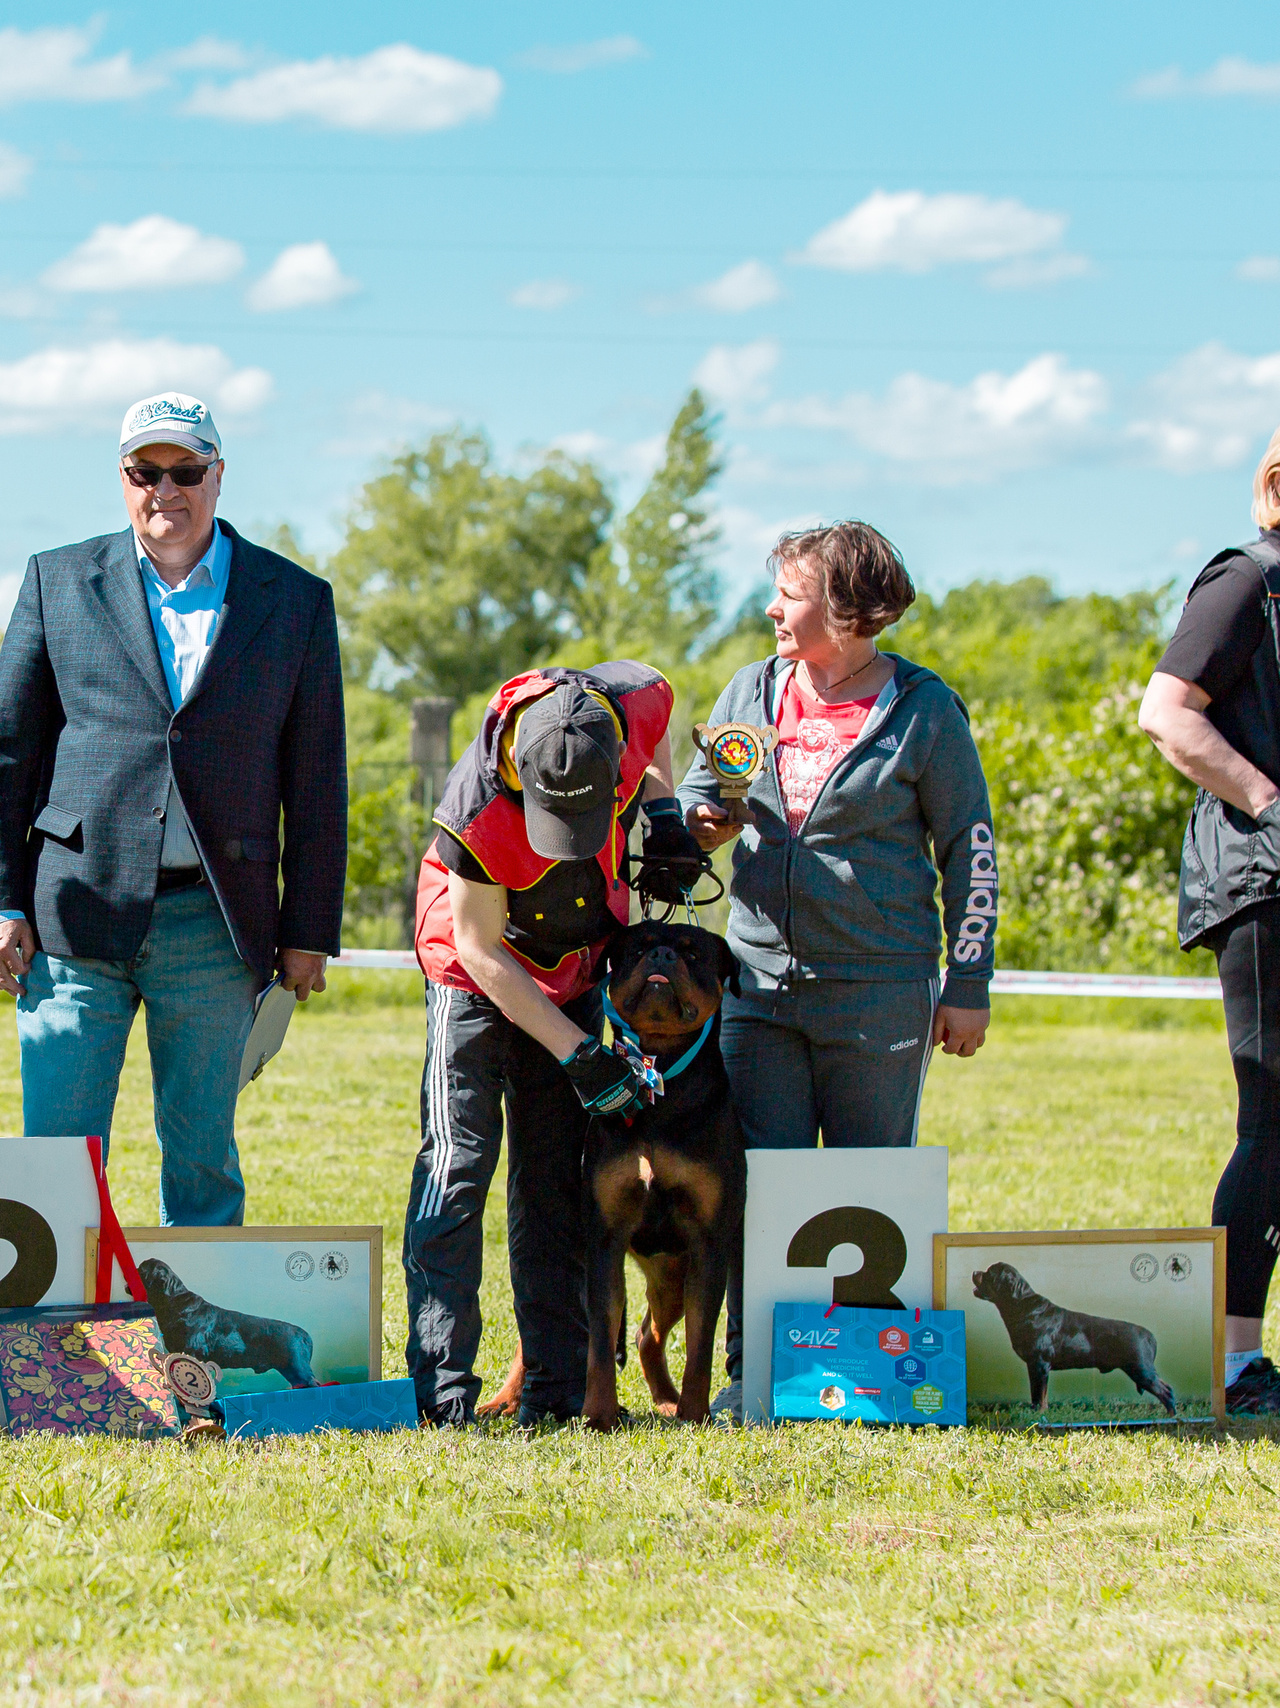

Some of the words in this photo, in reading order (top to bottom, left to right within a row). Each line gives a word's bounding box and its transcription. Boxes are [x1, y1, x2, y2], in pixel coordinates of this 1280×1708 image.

[727, 741, 742, 766] 3
[535, 781, 566, 797] BLACK
[567, 785, 593, 797] STAR
[954, 822, 998, 962] adidas
[890, 1037, 919, 1051] adidas
[797, 1329, 840, 1346] AVZ
[838, 1358, 869, 1366] PRODUCE
[185, 1371, 199, 1389] 2
[855, 1372, 874, 1380] WELL
